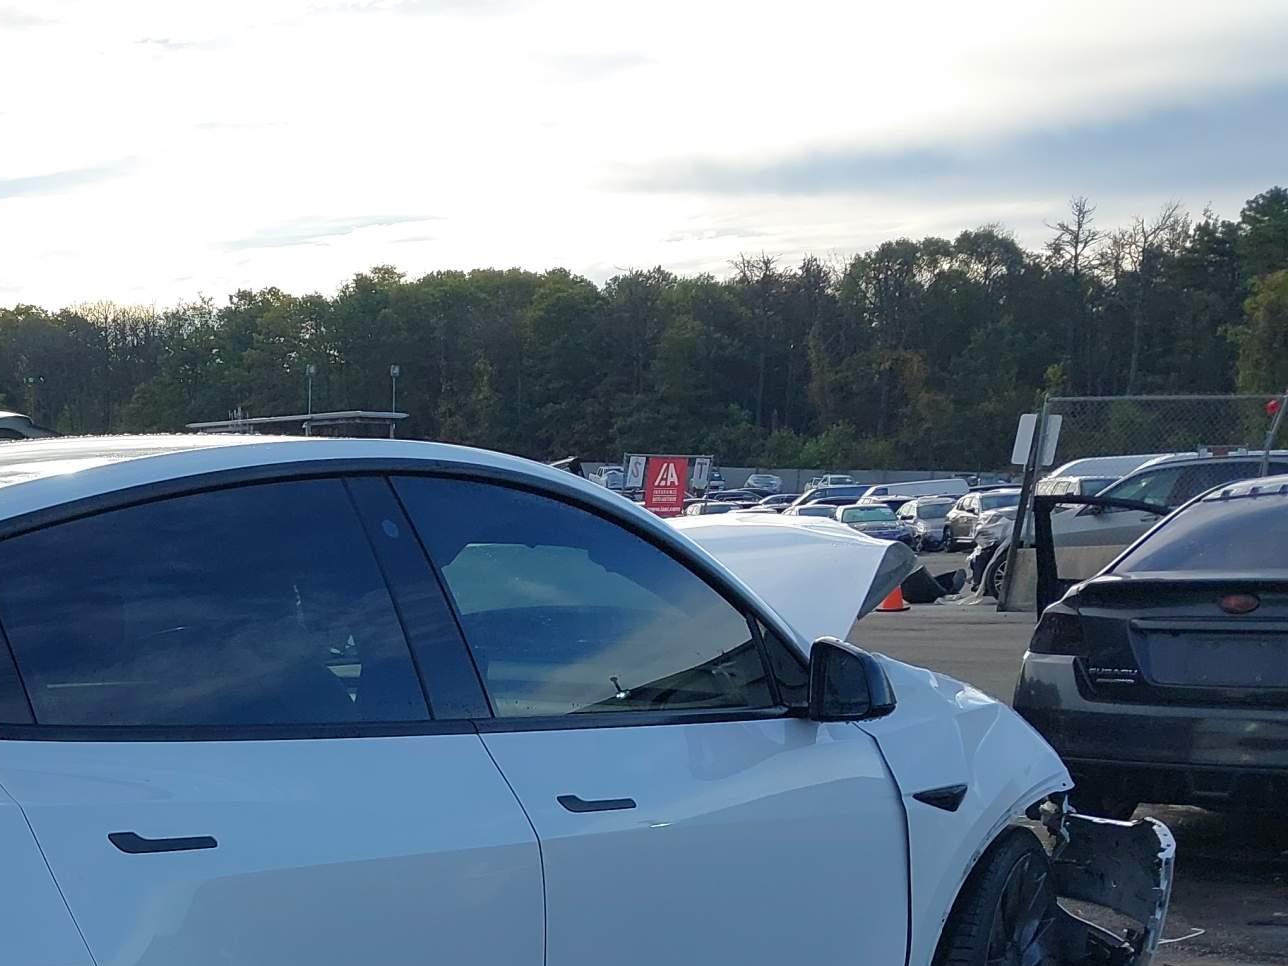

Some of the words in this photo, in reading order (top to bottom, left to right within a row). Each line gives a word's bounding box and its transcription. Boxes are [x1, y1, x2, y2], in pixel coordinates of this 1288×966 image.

[631, 461, 642, 479] S
[654, 462, 679, 487] IAA
[697, 461, 708, 481] T
